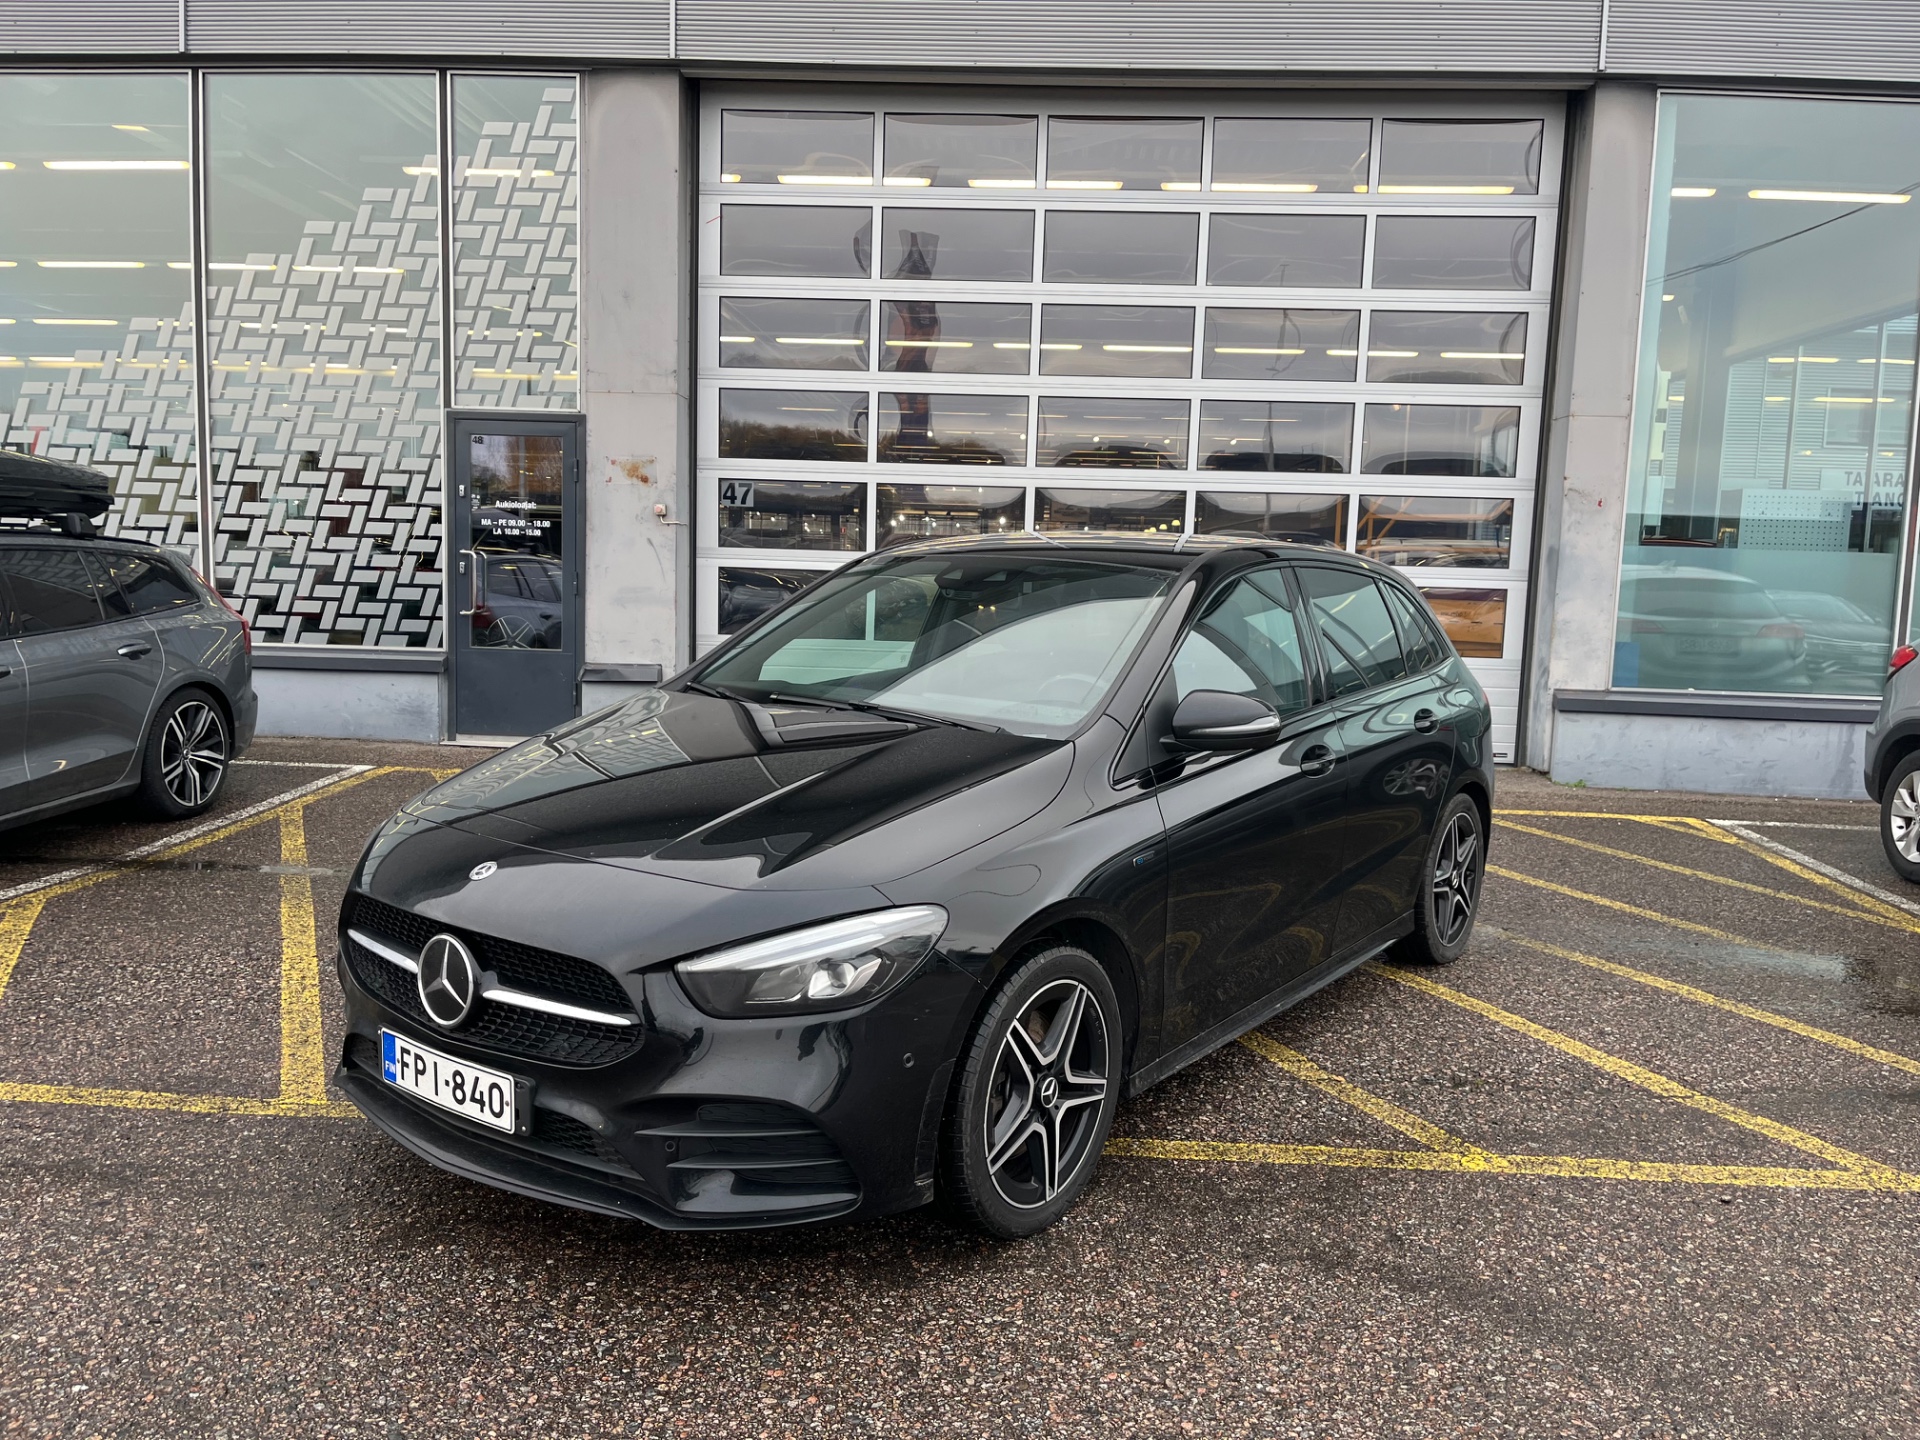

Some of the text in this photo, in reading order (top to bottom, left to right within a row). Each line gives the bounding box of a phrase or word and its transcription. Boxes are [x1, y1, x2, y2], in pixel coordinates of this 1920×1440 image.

[472, 436, 484, 444] 48
[723, 483, 752, 505] 47
[508, 519, 526, 527] 09.00
[533, 520, 551, 528] 18.00
[504, 528, 520, 536] 10.00
[385, 1060, 396, 1074] FIN
[400, 1046, 504, 1119] FPI-840
